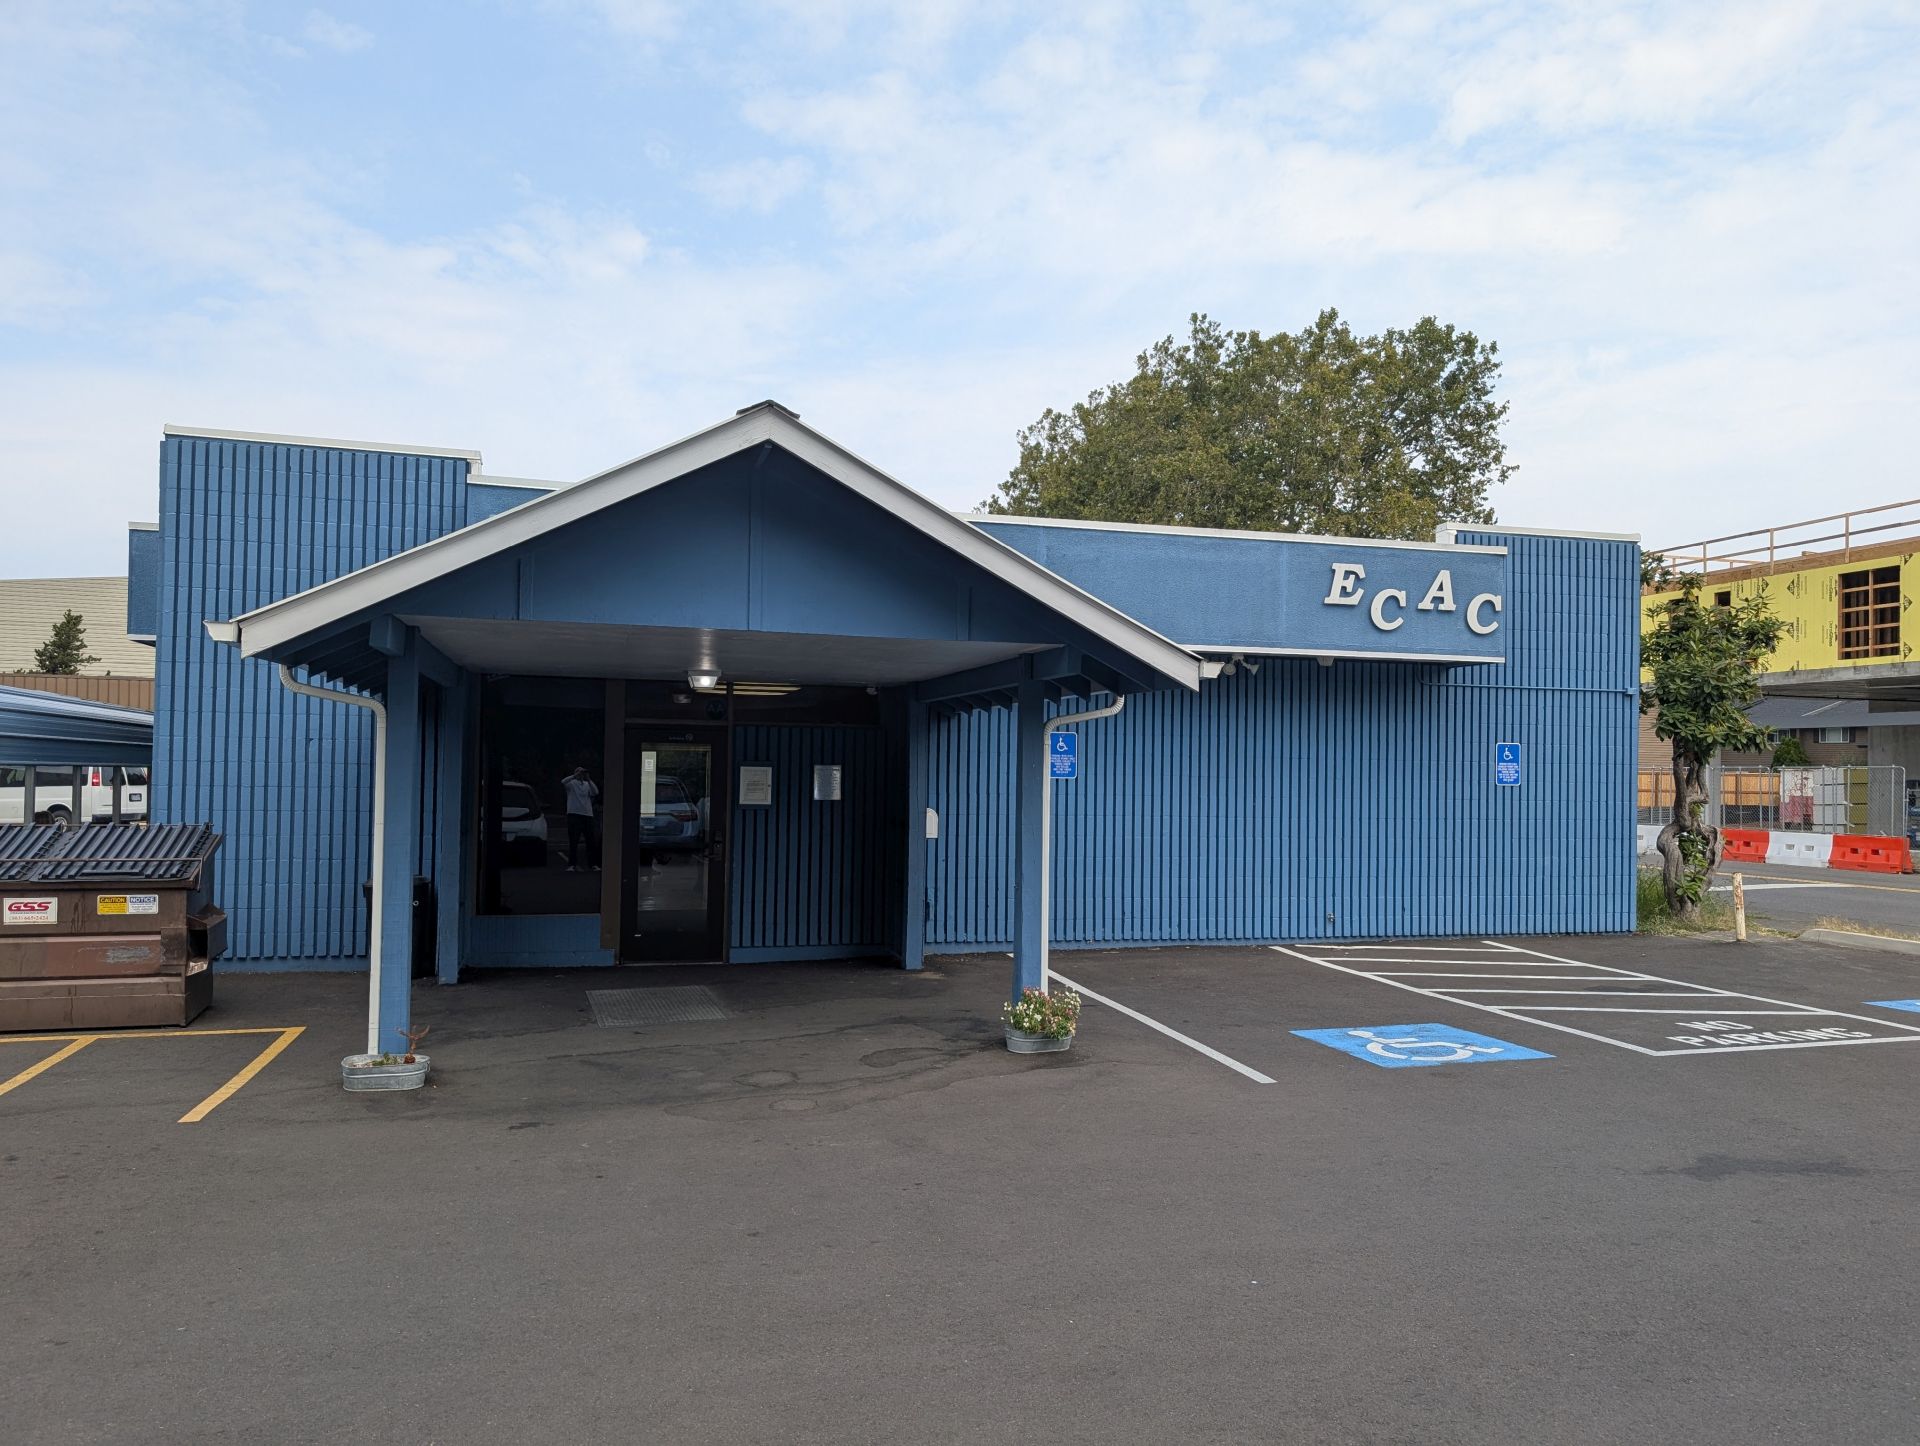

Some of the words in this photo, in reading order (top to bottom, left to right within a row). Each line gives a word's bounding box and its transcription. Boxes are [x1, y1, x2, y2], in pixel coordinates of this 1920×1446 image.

[1324, 563, 1502, 634] ECAC
[8, 901, 52, 912] GSS
[1675, 1020, 1753, 1031] NO
[1666, 1027, 1873, 1046] PARKING
